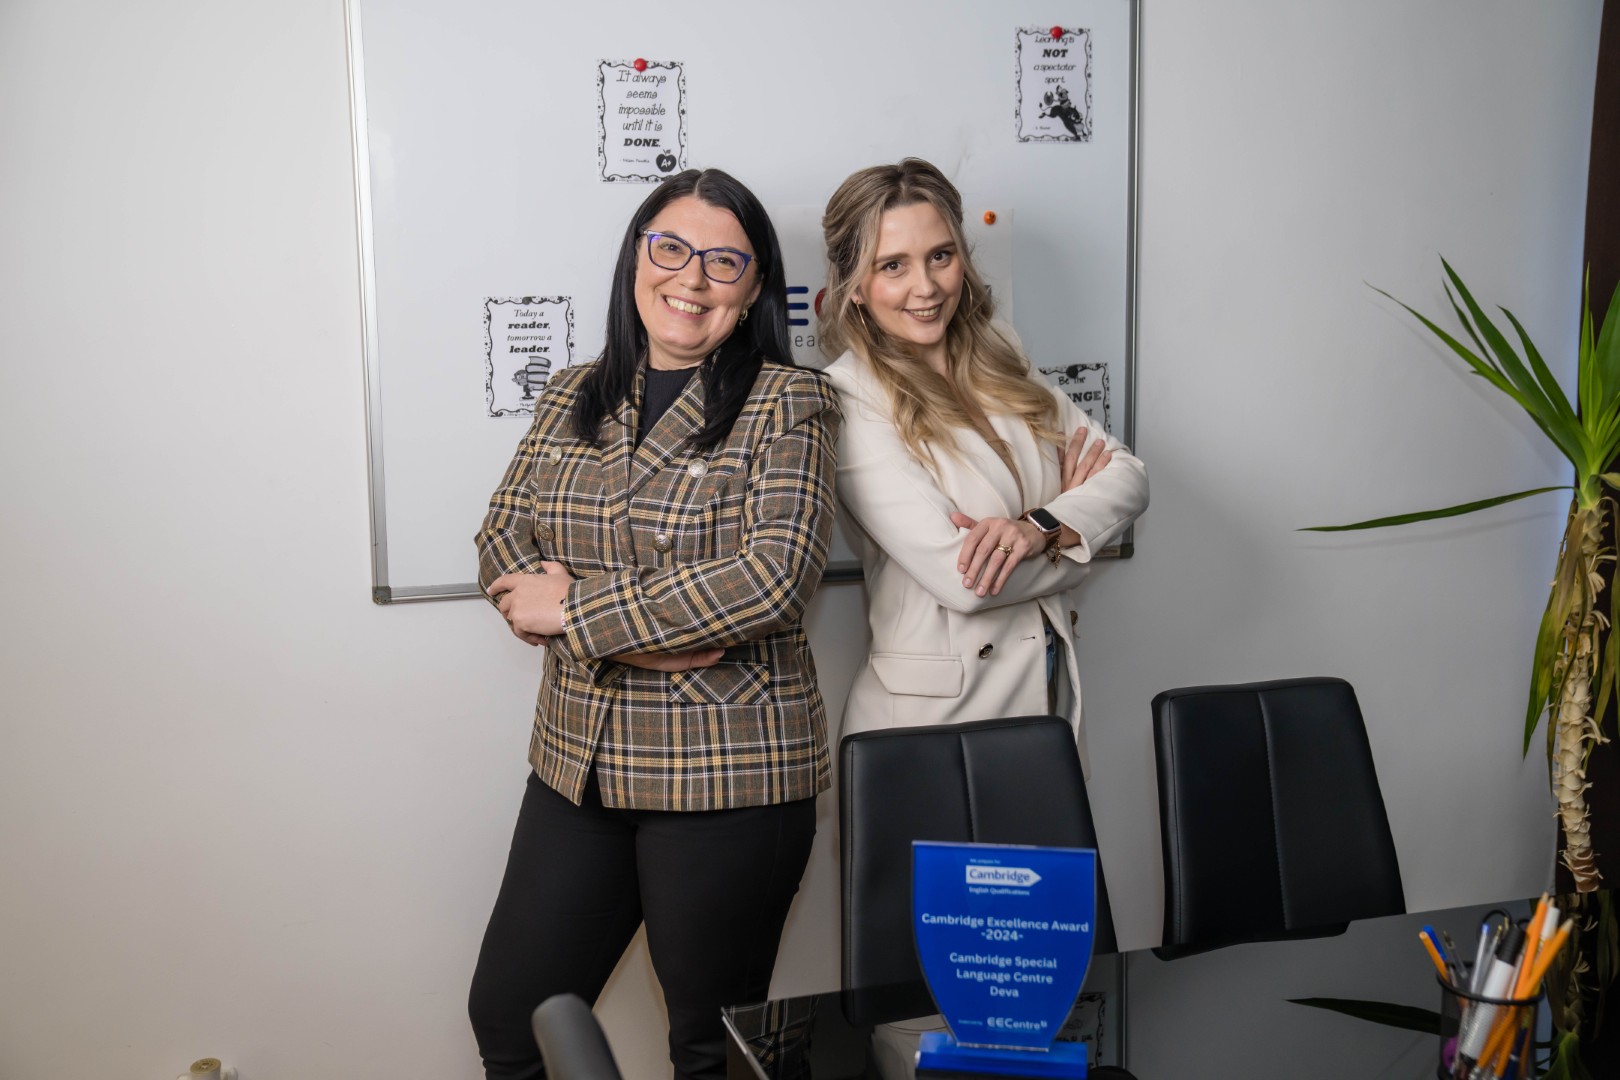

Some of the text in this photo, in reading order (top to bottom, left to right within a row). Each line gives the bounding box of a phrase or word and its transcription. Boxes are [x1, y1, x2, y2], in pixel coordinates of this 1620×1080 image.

[1042, 49, 1068, 58] NOT
[1040, 63, 1076, 72] spectator
[616, 70, 631, 82] It
[626, 90, 658, 99] seems
[618, 104, 666, 118] impossible
[623, 119, 663, 131] until it is
[624, 138, 660, 147] DONE.
[661, 158, 672, 168] A+
[514, 309, 538, 320] Today
[508, 321, 550, 330] reader,
[509, 345, 550, 353] leader.
[1058, 376, 1070, 386] Be
[1068, 391, 1102, 403] NGE
[969, 868, 1030, 884] Cambridge
[922, 913, 1089, 932] Cambridge Excellence Award
[981, 929, 1023, 941] -2024-
[950, 952, 1058, 969] Cambridge Special
[956, 968, 1053, 984] Language Centre
[990, 986, 1019, 998] Deva
